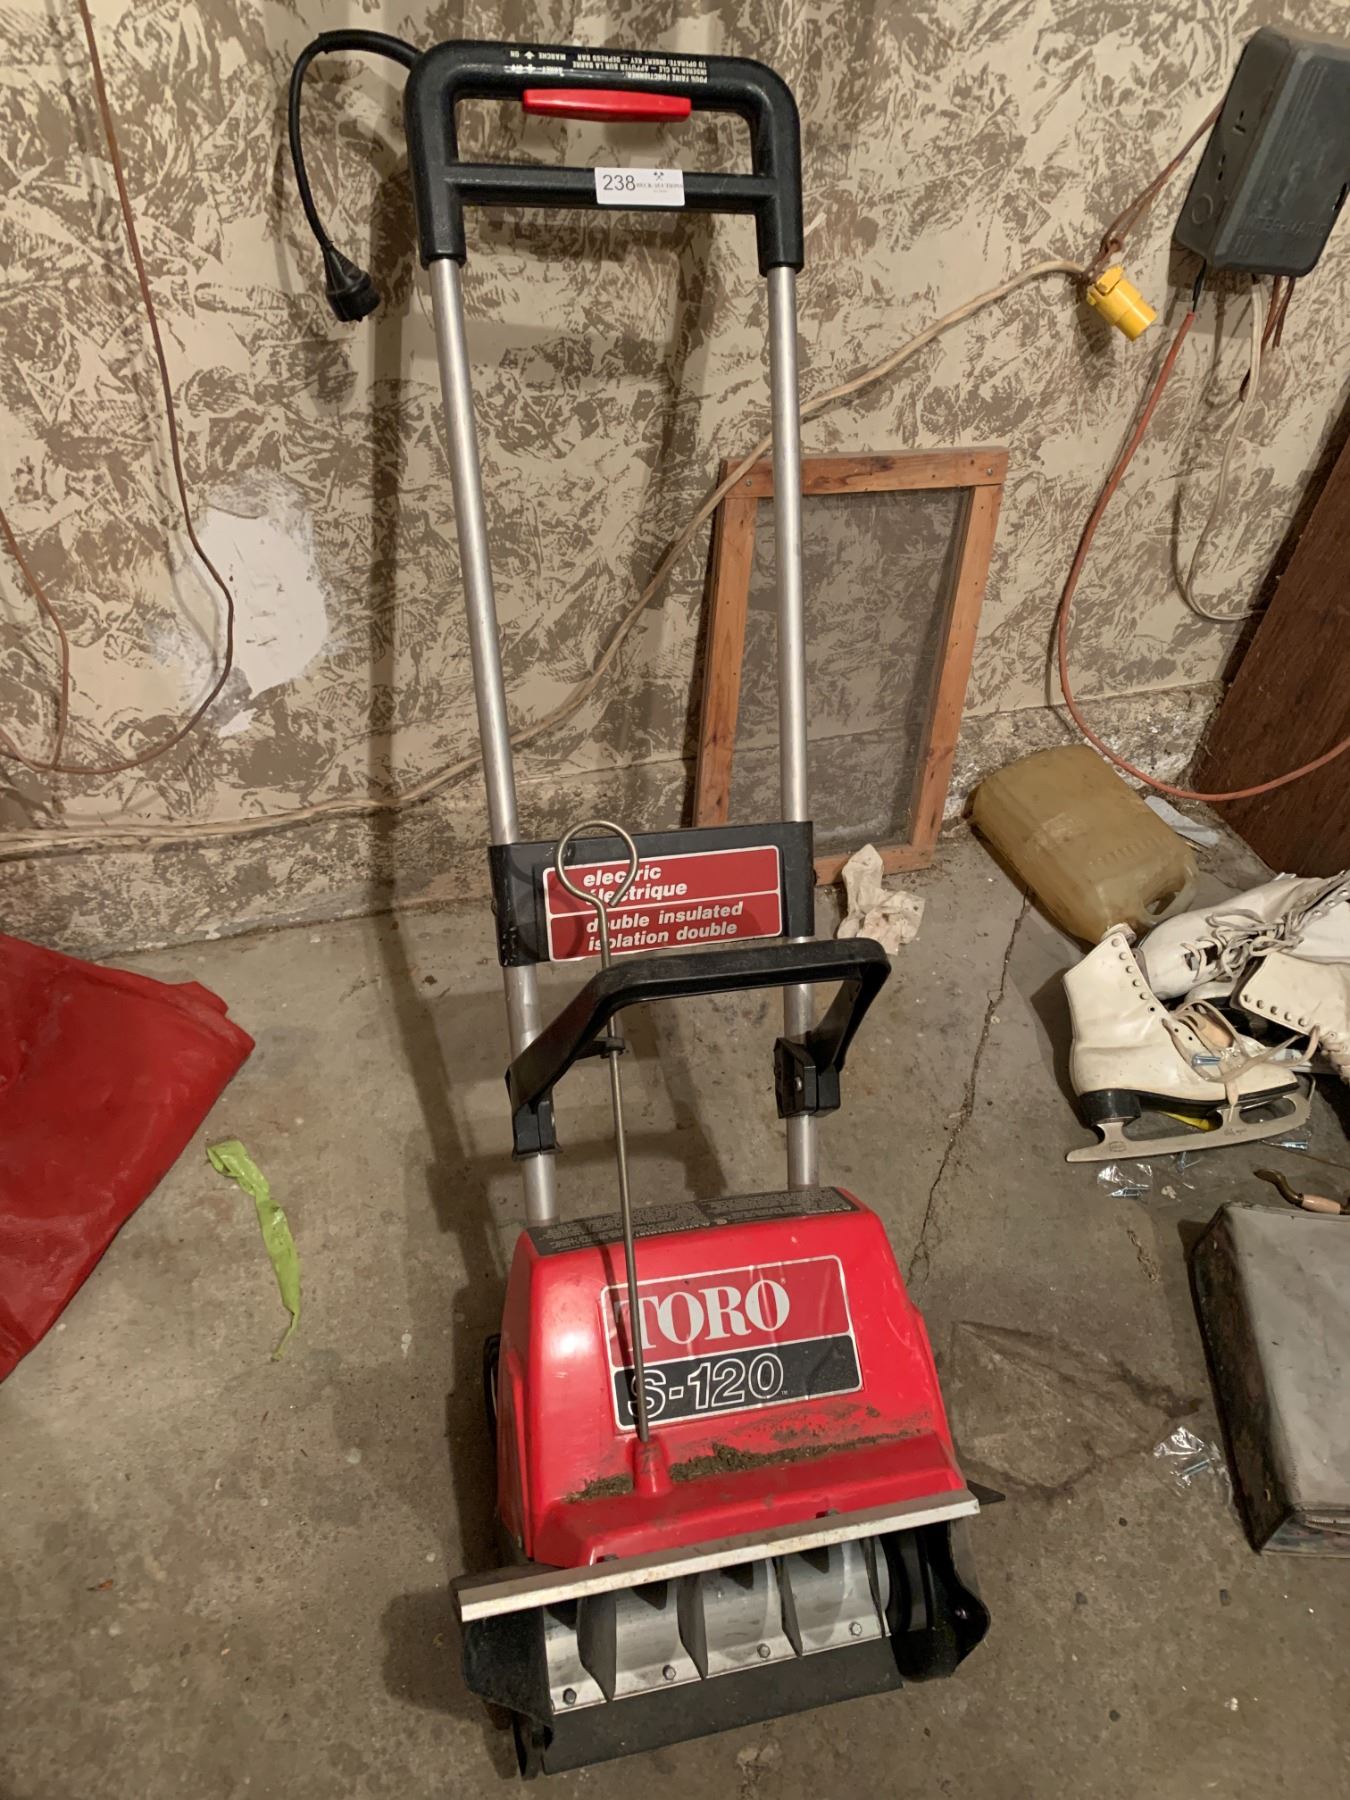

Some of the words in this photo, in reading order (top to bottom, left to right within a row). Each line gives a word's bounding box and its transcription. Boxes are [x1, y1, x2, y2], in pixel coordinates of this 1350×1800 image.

[593, 55, 620, 63] DEPRESS
[645, 58, 666, 66] INSERT
[572, 61, 594, 69] BARRE
[595, 61, 603, 69] LA
[605, 62, 618, 70] SUR
[672, 74, 689, 82] FAIRE
[691, 75, 708, 84] POUR
[602, 174, 636, 191] 238
[583, 865, 662, 887] elecric
[586, 913, 650, 933] duble
[658, 901, 743, 925] insulated
[675, 921, 738, 941] double
[613, 1279, 790, 1351] TORO
[627, 1353, 784, 1418] S-120
